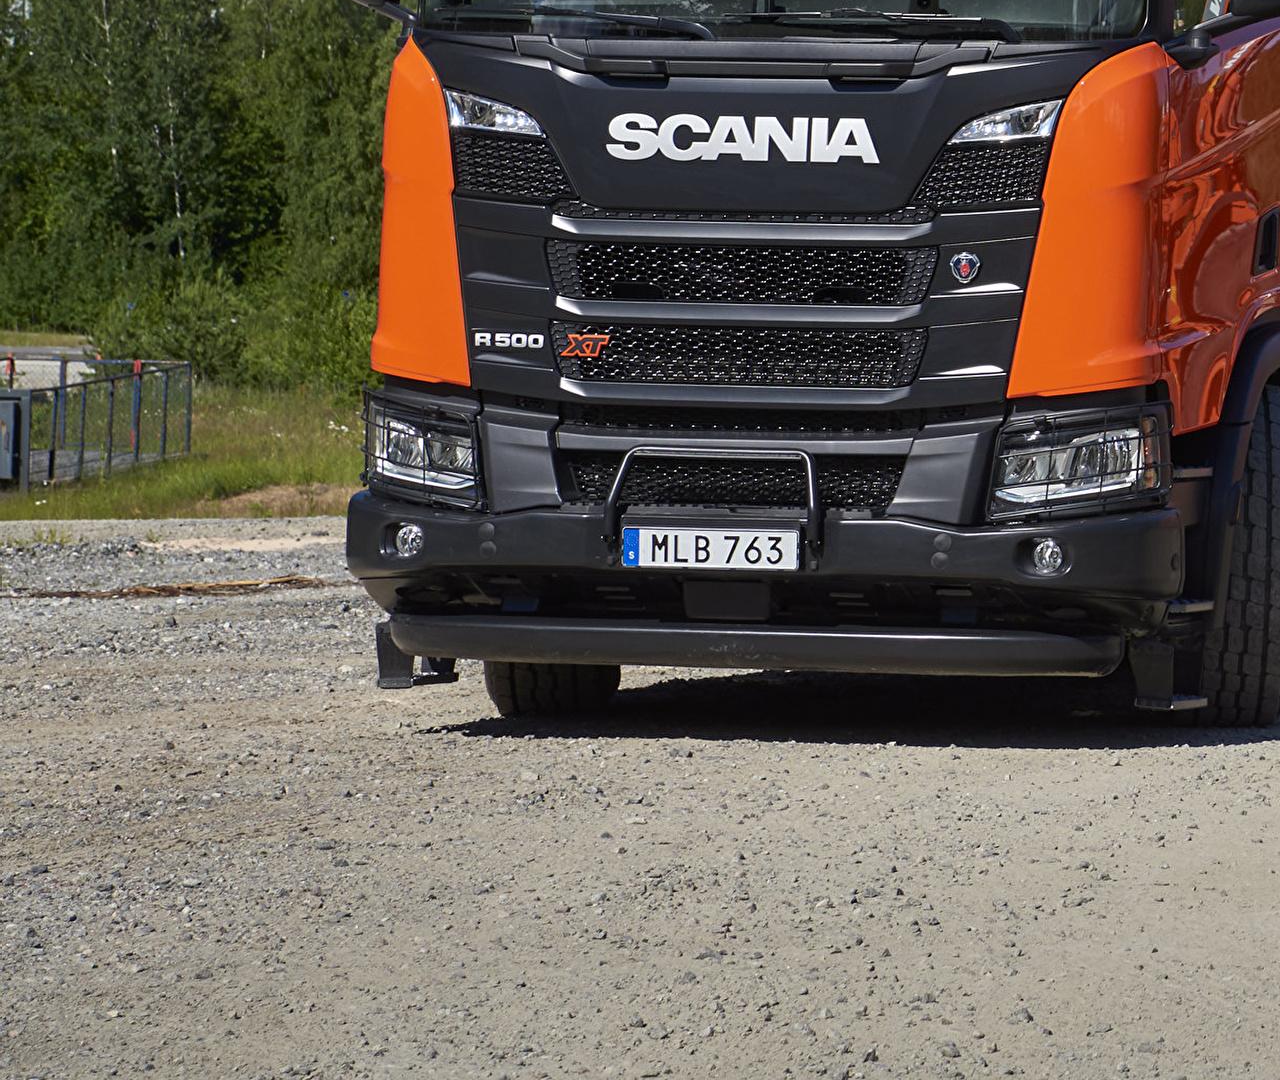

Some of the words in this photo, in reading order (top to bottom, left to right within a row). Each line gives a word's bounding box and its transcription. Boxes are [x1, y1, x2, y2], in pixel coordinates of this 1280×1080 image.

[605, 112, 880, 164] SCANIA
[474, 332, 491, 347] R
[494, 333, 544, 349] 500
[560, 333, 611, 357] XT
[628, 551, 635, 560] S
[651, 534, 711, 563] MLB
[723, 536, 783, 565] 763
